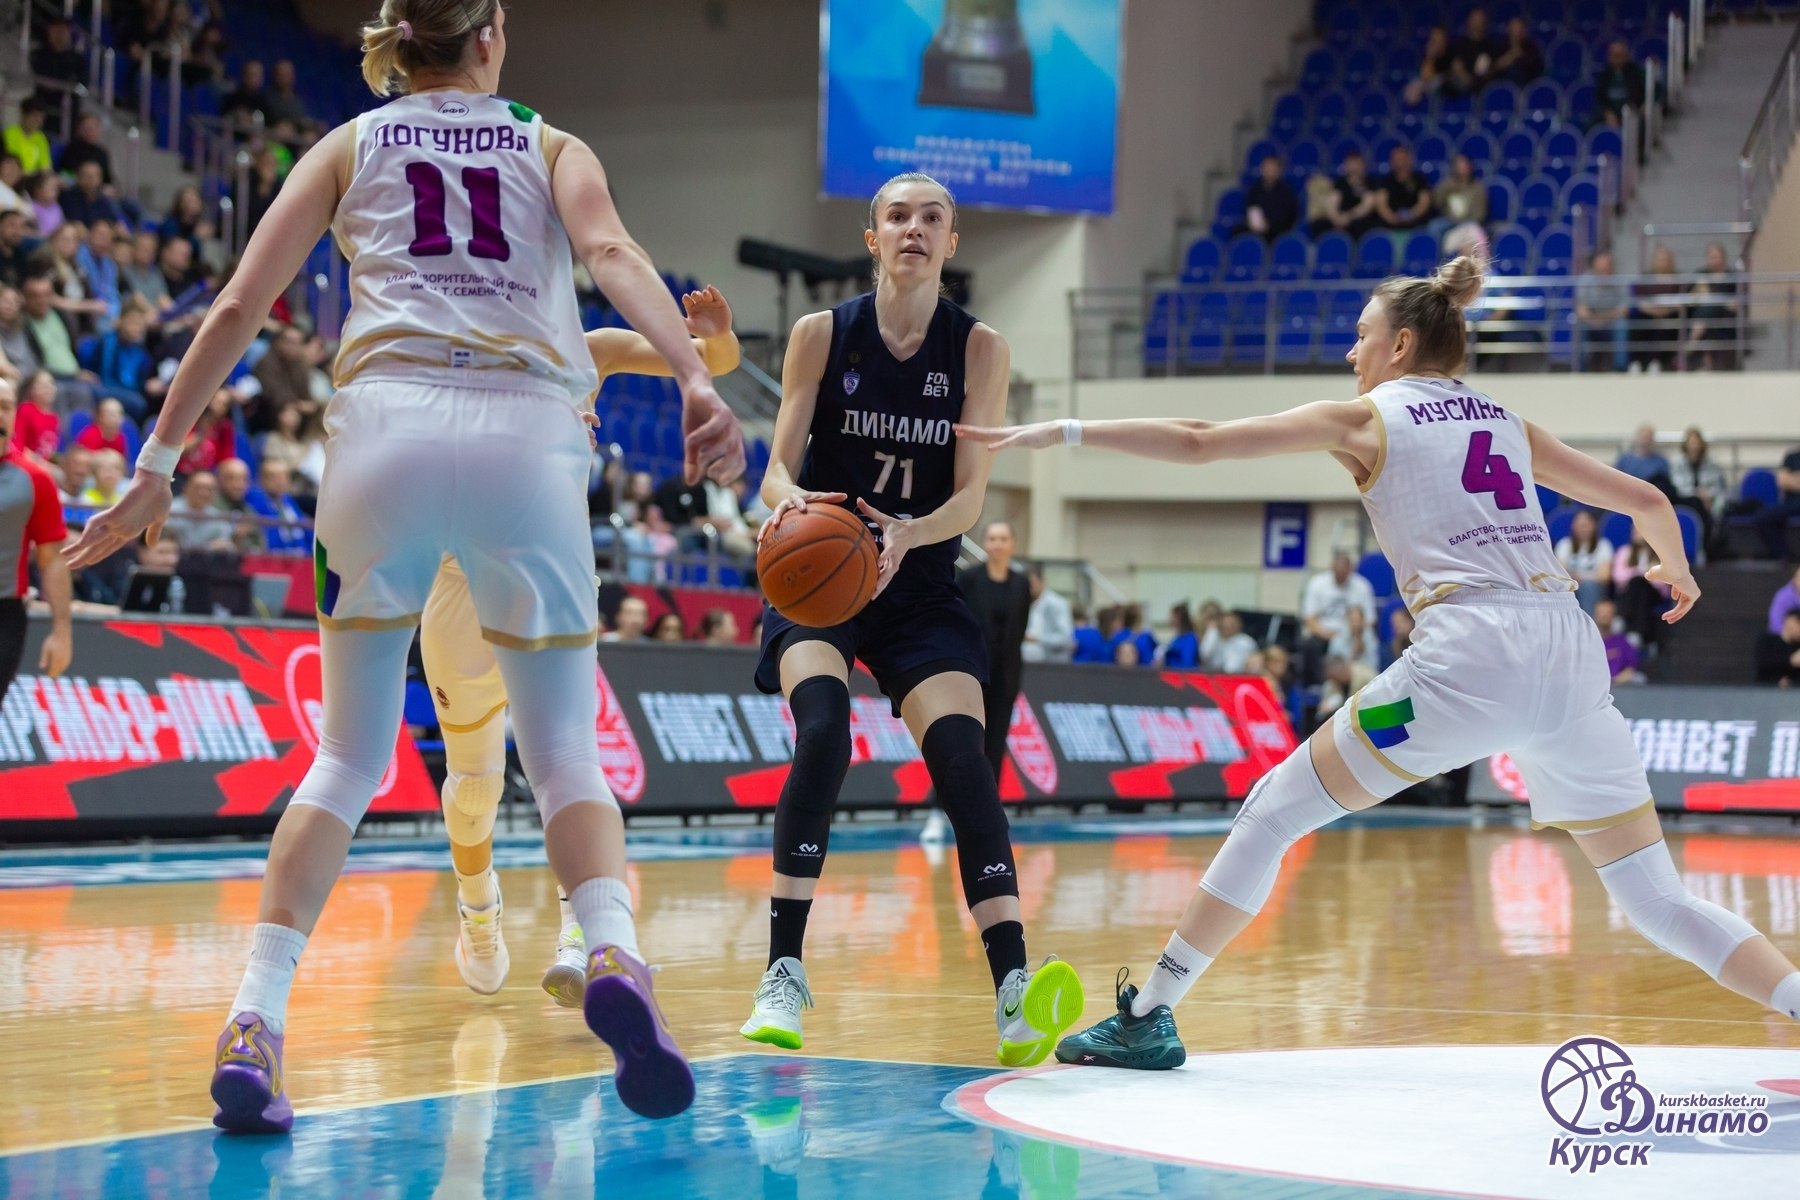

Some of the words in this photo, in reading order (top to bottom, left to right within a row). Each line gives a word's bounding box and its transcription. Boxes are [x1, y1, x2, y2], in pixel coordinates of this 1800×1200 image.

[405, 161, 510, 262] 11
[922, 384, 950, 397] BET
[925, 372, 950, 386] FON
[840, 409, 951, 446] ДИНАМО
[872, 450, 914, 500] 71
[1461, 430, 1527, 511] 4
[1269, 518, 1301, 562] F
[1627, 718, 1757, 777] ONBET
[1163, 952, 1190, 975] eebok
